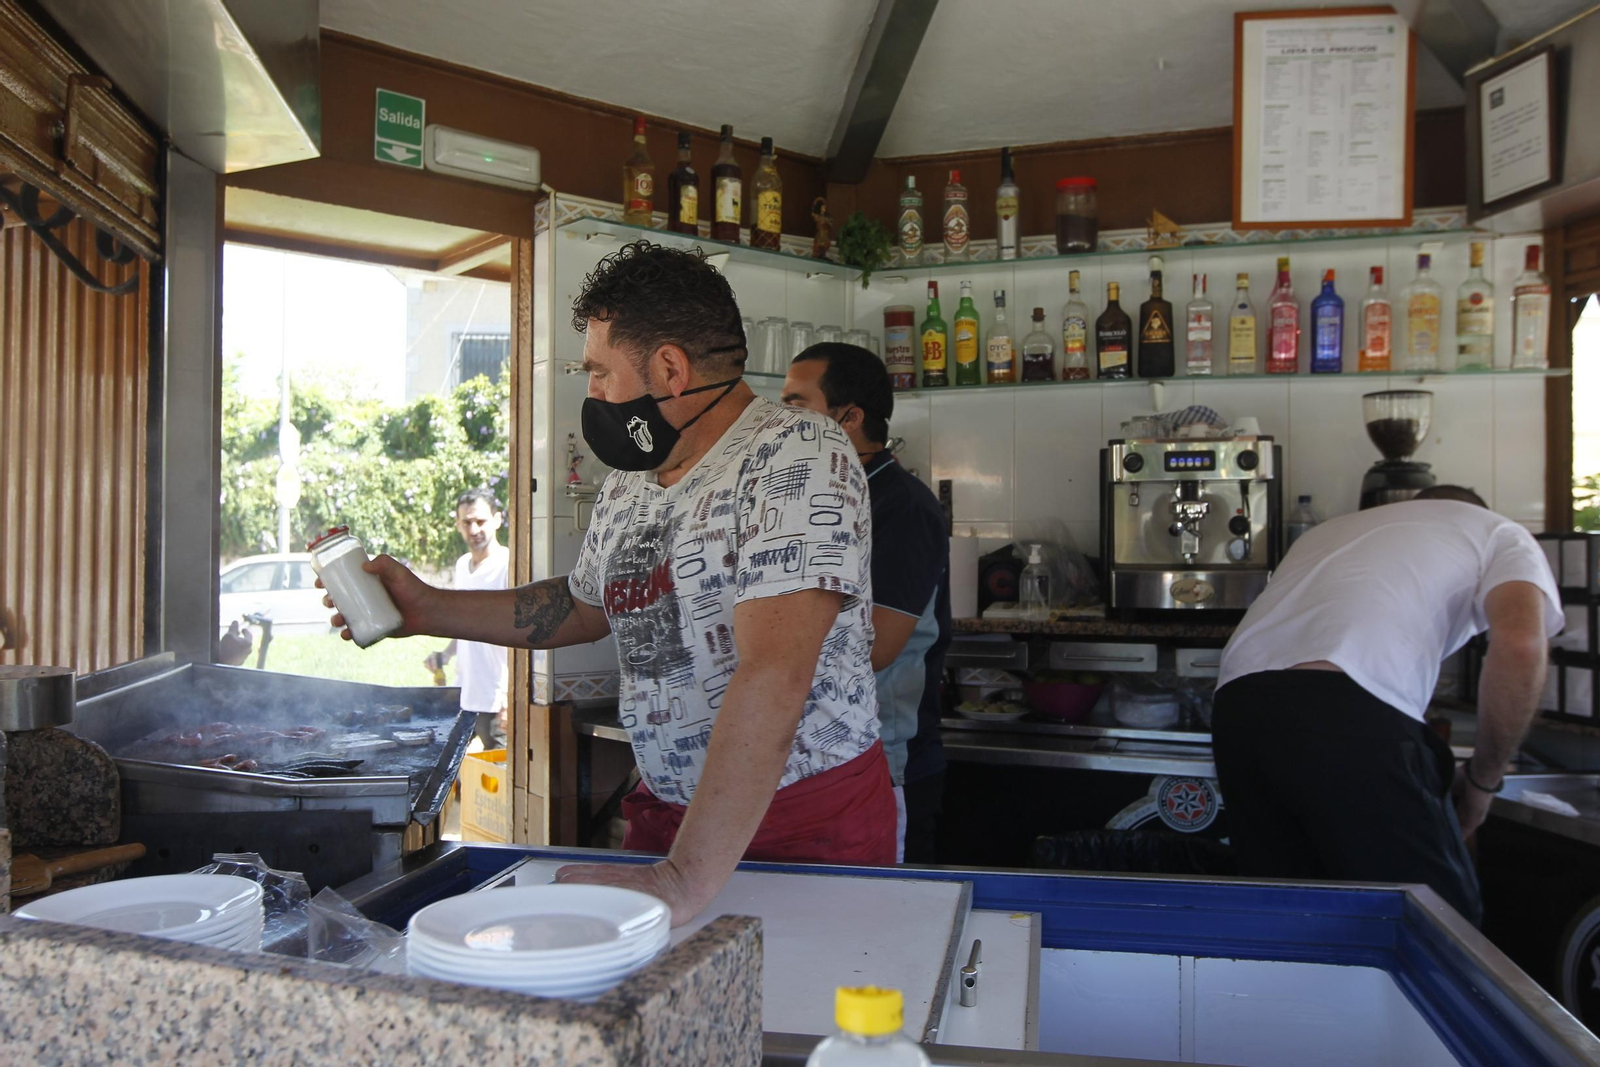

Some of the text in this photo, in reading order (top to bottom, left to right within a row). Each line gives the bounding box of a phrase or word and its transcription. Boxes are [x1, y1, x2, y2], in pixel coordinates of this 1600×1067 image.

[1329, 45, 1377, 53] PRECIOS
[379, 107, 420, 129] Salida
[923, 341, 942, 361] J&B
